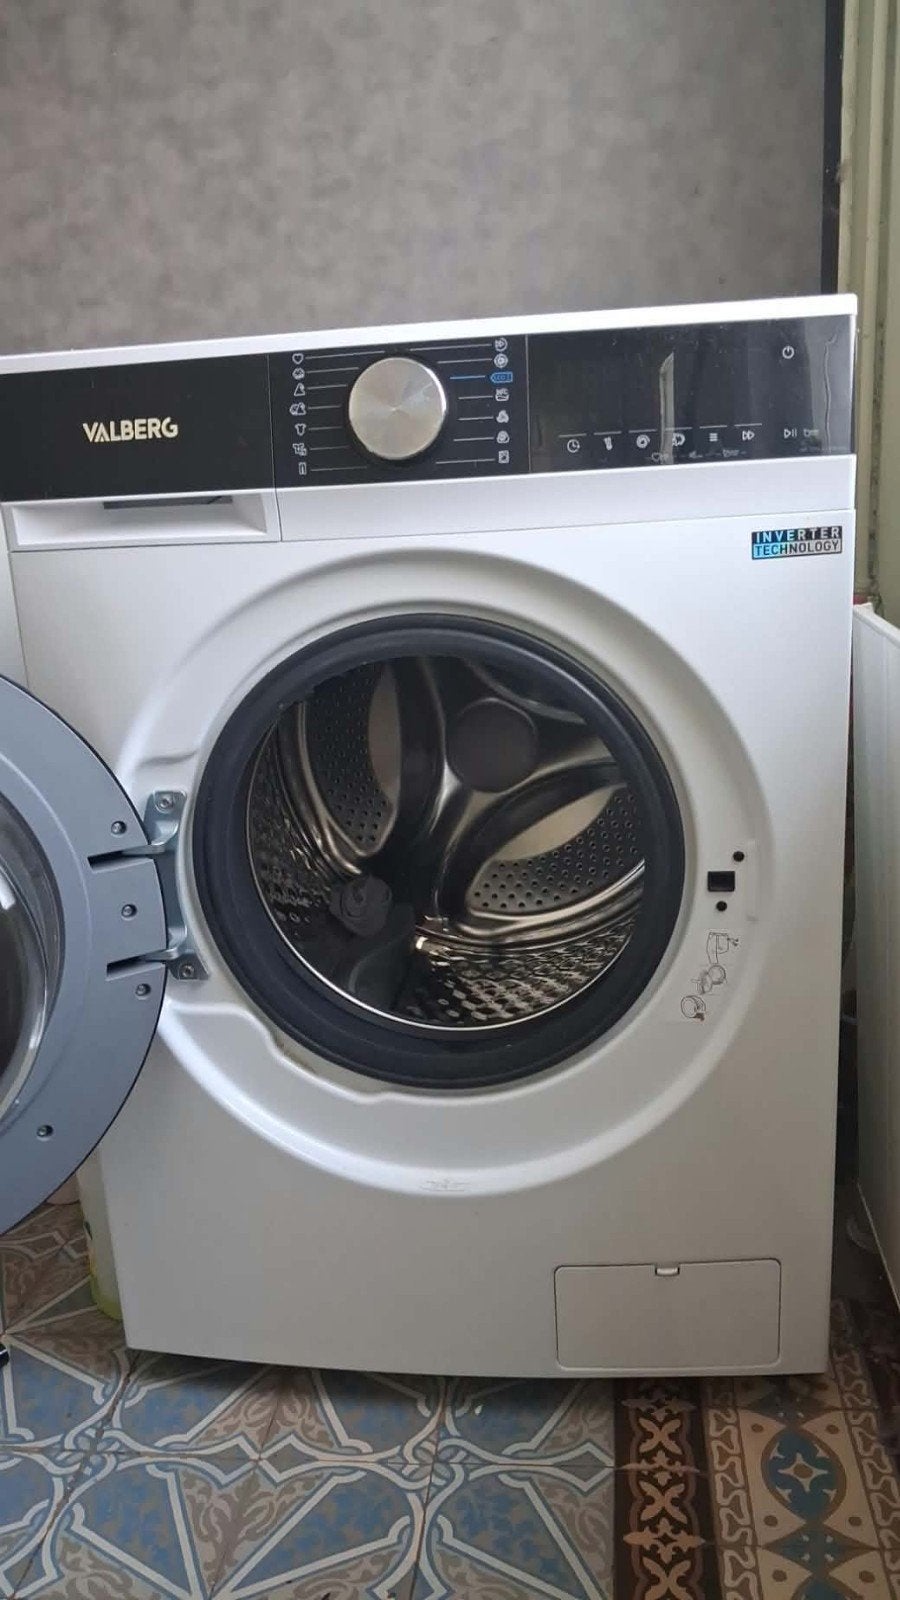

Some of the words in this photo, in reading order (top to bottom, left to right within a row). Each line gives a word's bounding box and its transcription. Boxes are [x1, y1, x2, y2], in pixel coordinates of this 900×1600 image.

[82, 416, 179, 443] VALBERG
[756, 527, 840, 543] INVERTER
[755, 540, 839, 556] TECHNOLOGY
